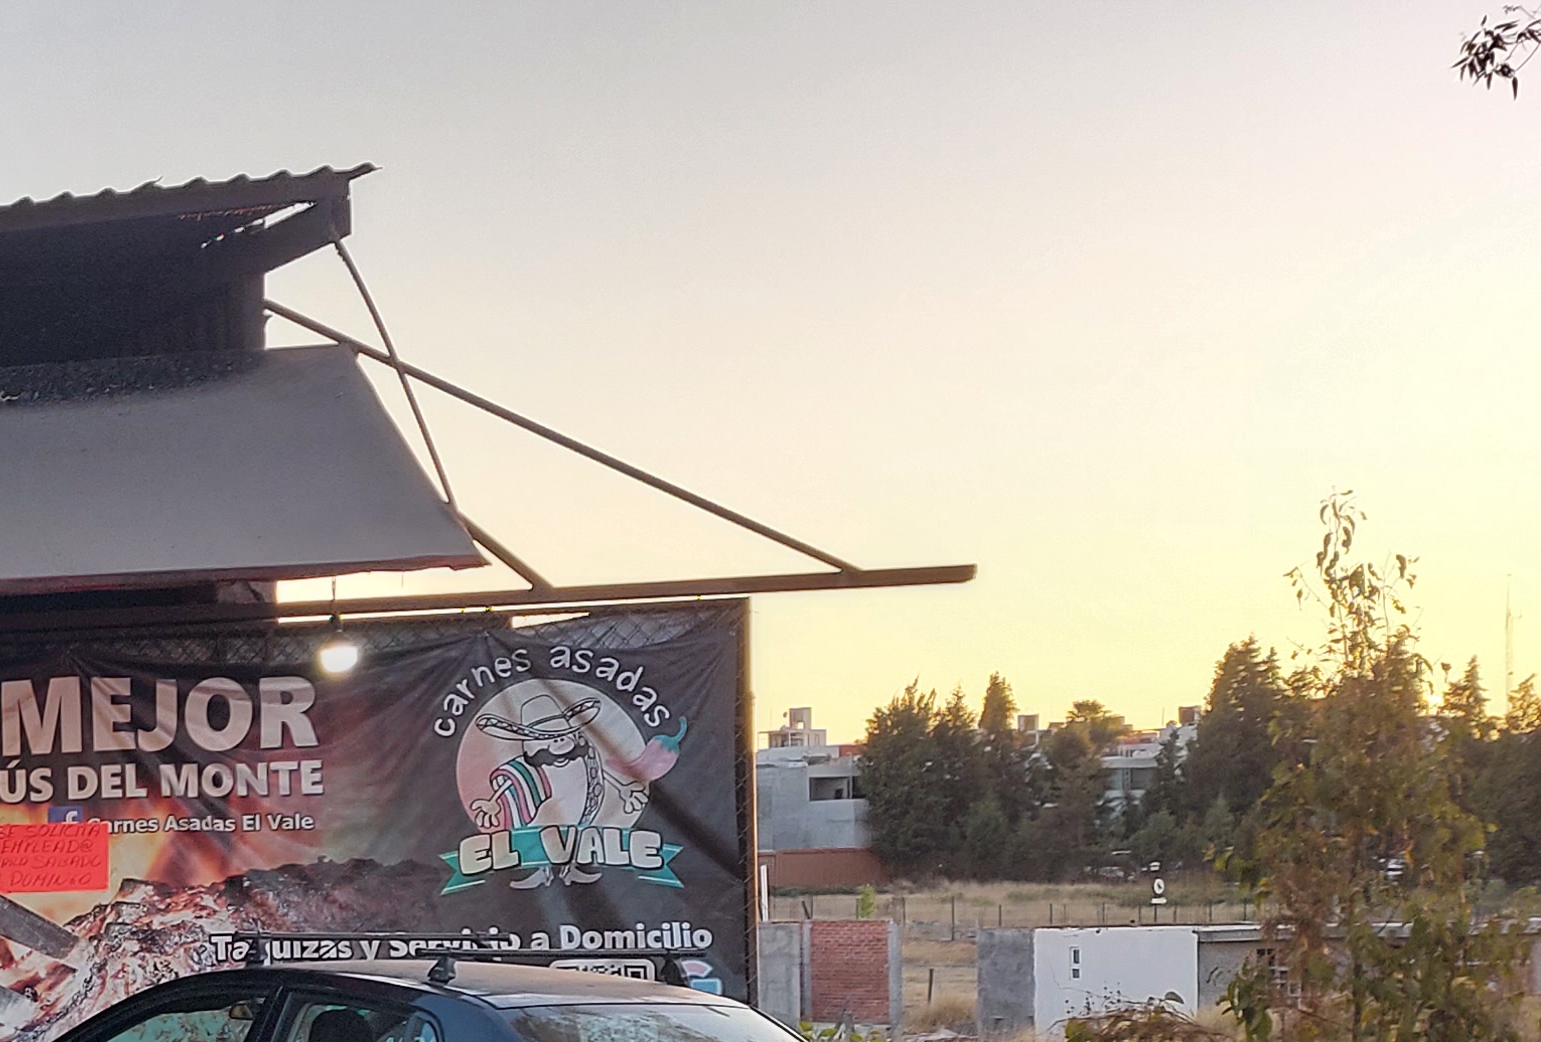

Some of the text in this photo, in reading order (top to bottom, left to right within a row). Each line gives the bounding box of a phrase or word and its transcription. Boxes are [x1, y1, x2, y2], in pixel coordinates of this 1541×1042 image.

[434, 645, 670, 737] carnes asadas
[0, 676, 319, 757] MEJOR
[68, 765, 148, 801] DEL
[160, 760, 325, 798] MONTE
[87, 817, 159, 834] arnes
[164, 814, 236, 832] Asadas
[243, 814, 261, 831] El
[267, 812, 315, 831] Vale
[459, 825, 664, 875] EL VALE
[530, 931, 551, 950] a
[559, 921, 713, 951] Domicilio
